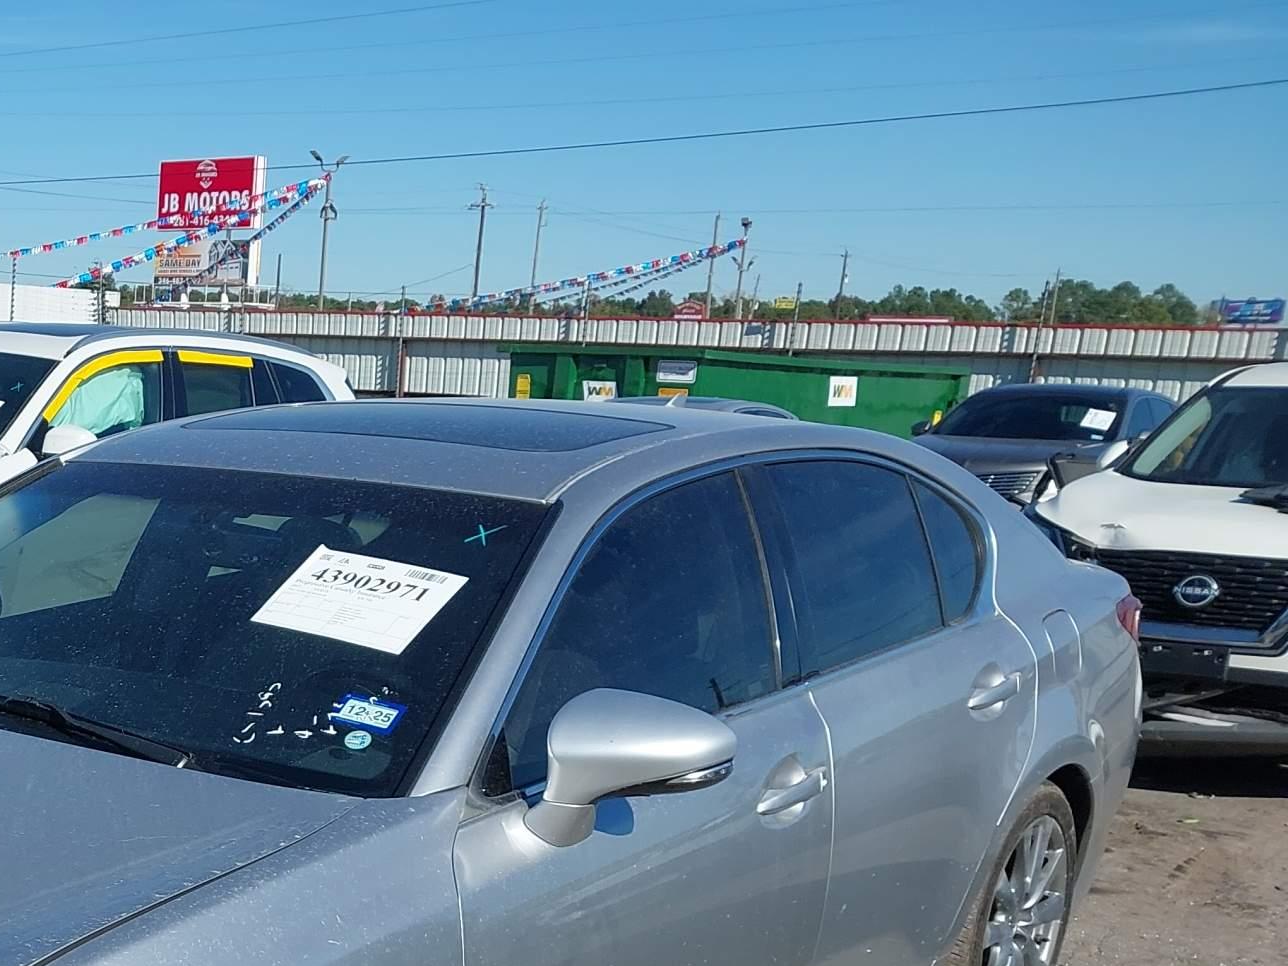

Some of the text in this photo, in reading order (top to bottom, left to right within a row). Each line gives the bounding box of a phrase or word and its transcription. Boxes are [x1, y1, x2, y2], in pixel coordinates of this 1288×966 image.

[161, 190, 249, 213] JB MOTORS
[159, 258, 184, 267] SAME
[311, 567, 430, 601] 43902971
[1173, 586, 1220, 596] NISSAN
[373, 710, 394, 722] 25
